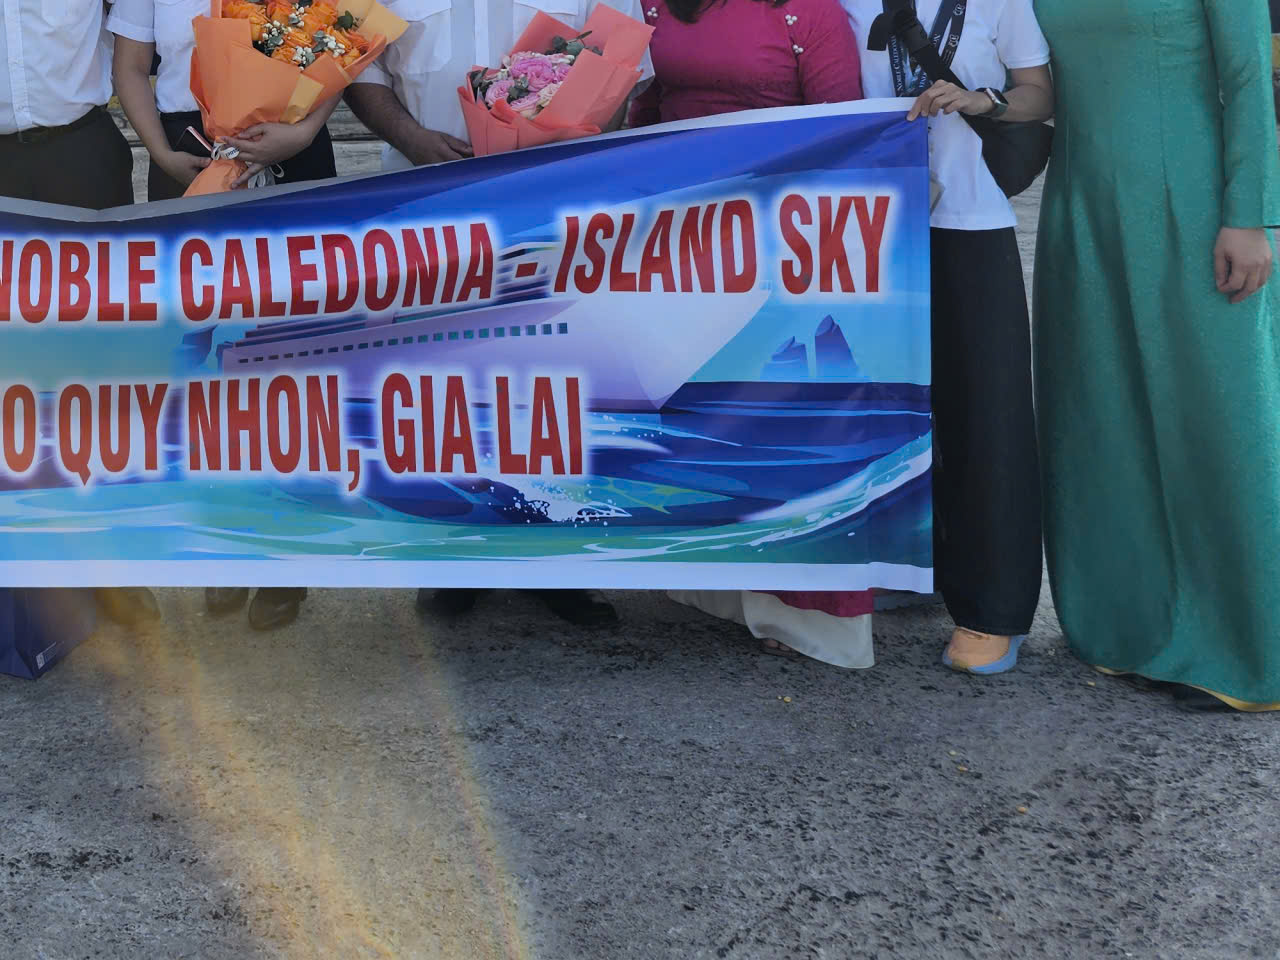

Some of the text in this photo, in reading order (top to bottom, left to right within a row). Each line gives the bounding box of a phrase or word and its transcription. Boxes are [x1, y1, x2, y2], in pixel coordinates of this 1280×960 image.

[179, 222, 495, 322] CALEDONIA
[515, 262, 539, 278] -
[553, 199, 757, 294] ISLAND
[779, 193, 891, 294] SKY
[56, 382, 169, 486] QUY
[188, 374, 361, 492] NHON,
[381, 372, 477, 474] GIA
[495, 375, 584, 475] LAI
